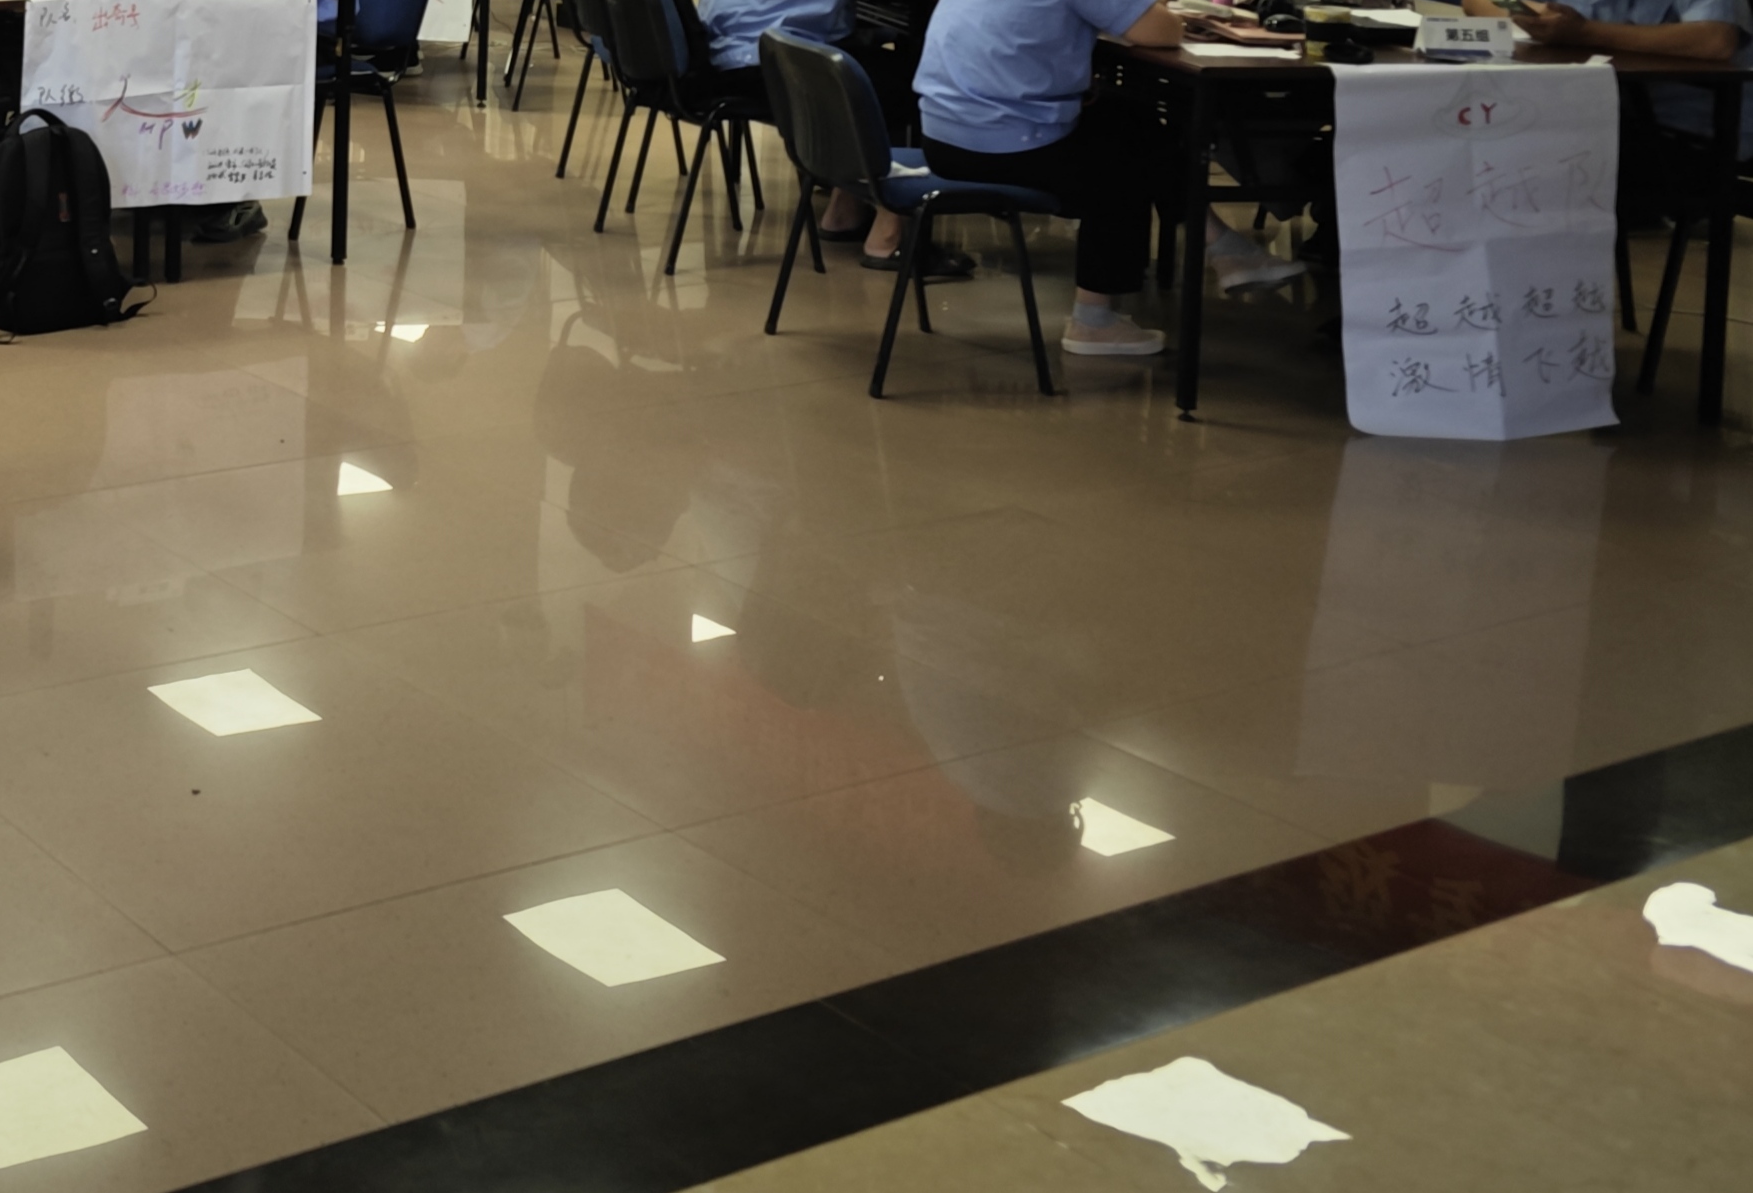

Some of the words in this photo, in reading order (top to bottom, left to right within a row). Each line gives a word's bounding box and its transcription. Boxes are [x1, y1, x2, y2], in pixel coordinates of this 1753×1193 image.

[1445, 28, 1490, 42] 第五组
[1457, 102, 1496, 126] CY
[1363, 150, 1609, 253] 超越队
[1385, 279, 1607, 337] 超越超越
